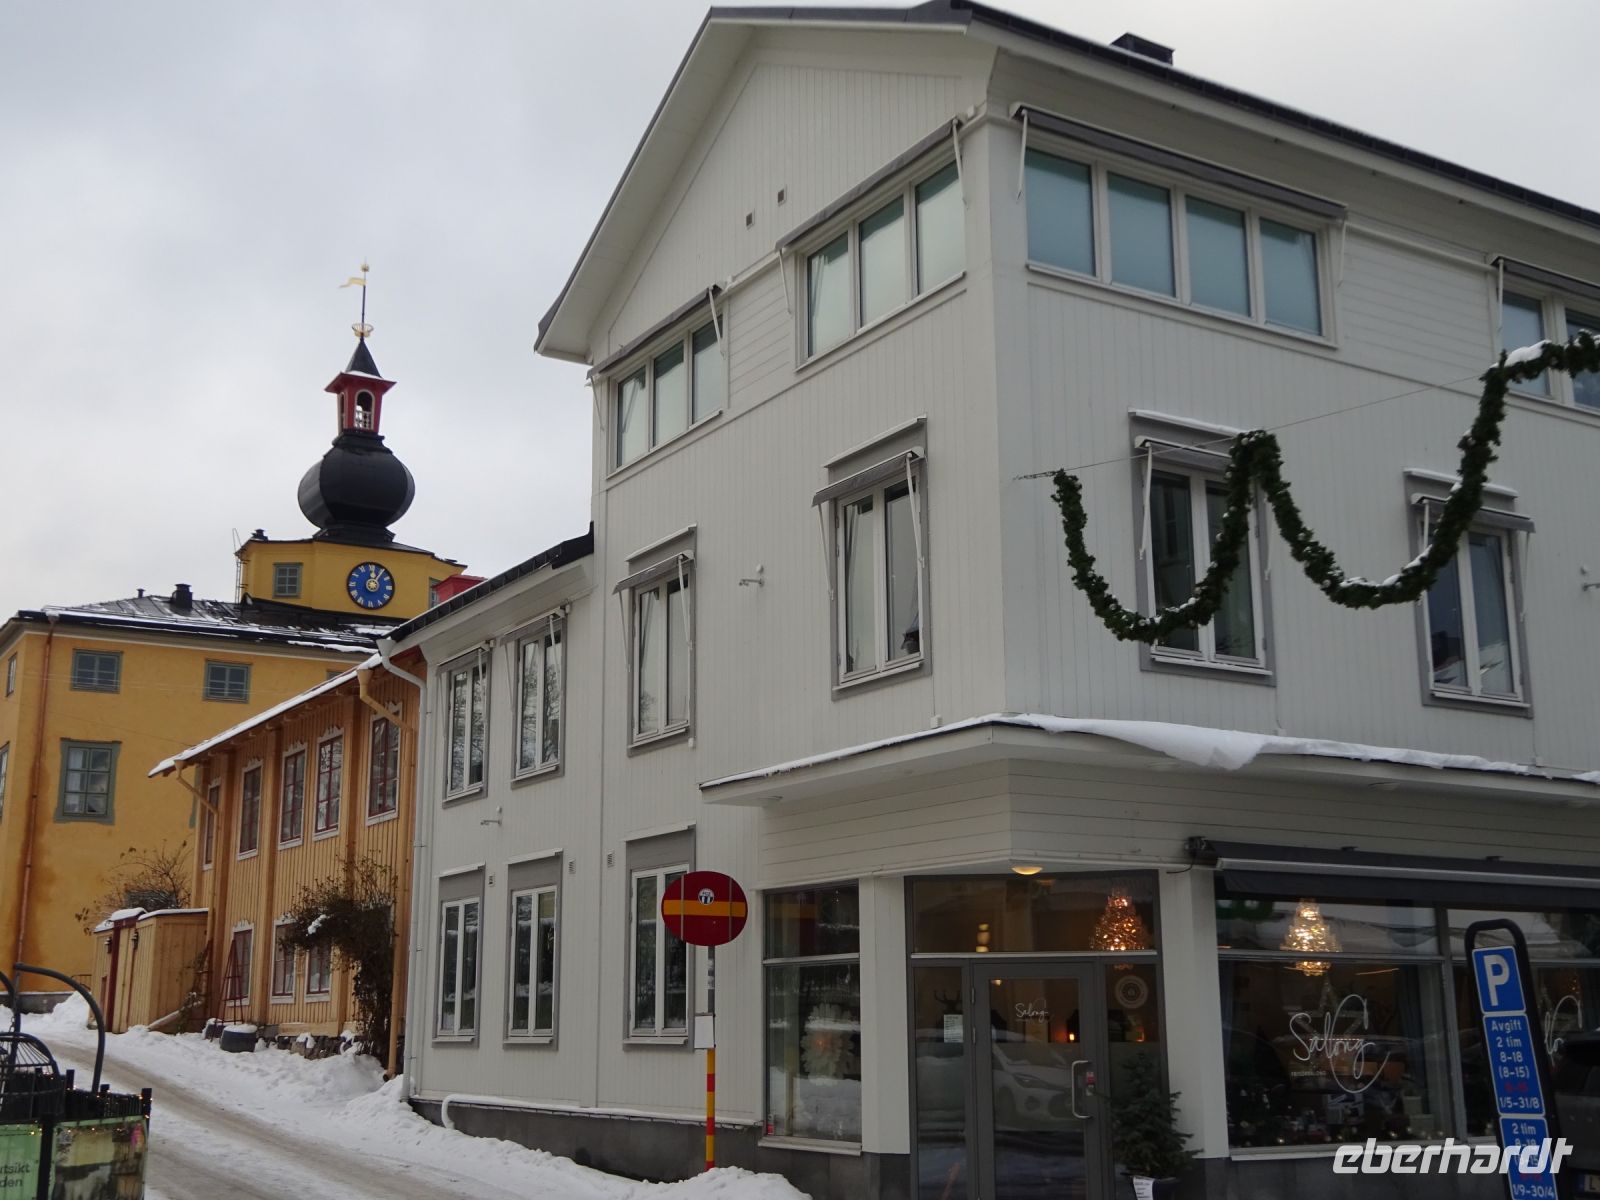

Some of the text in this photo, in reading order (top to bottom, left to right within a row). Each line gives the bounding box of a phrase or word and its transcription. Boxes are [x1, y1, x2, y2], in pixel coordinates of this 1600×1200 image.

[1483, 954, 1510, 1007] P
[1491, 1019, 1522, 1035] Avgift
[1496, 1036, 1522, 1048] 2 tim
[1500, 1051, 1523, 1063] 8-18
[1499, 1065, 1530, 1079] (8-15)
[1499, 1096, 1540, 1110] 1/5-31/8
[1511, 1122, 1537, 1135] 2 tim
